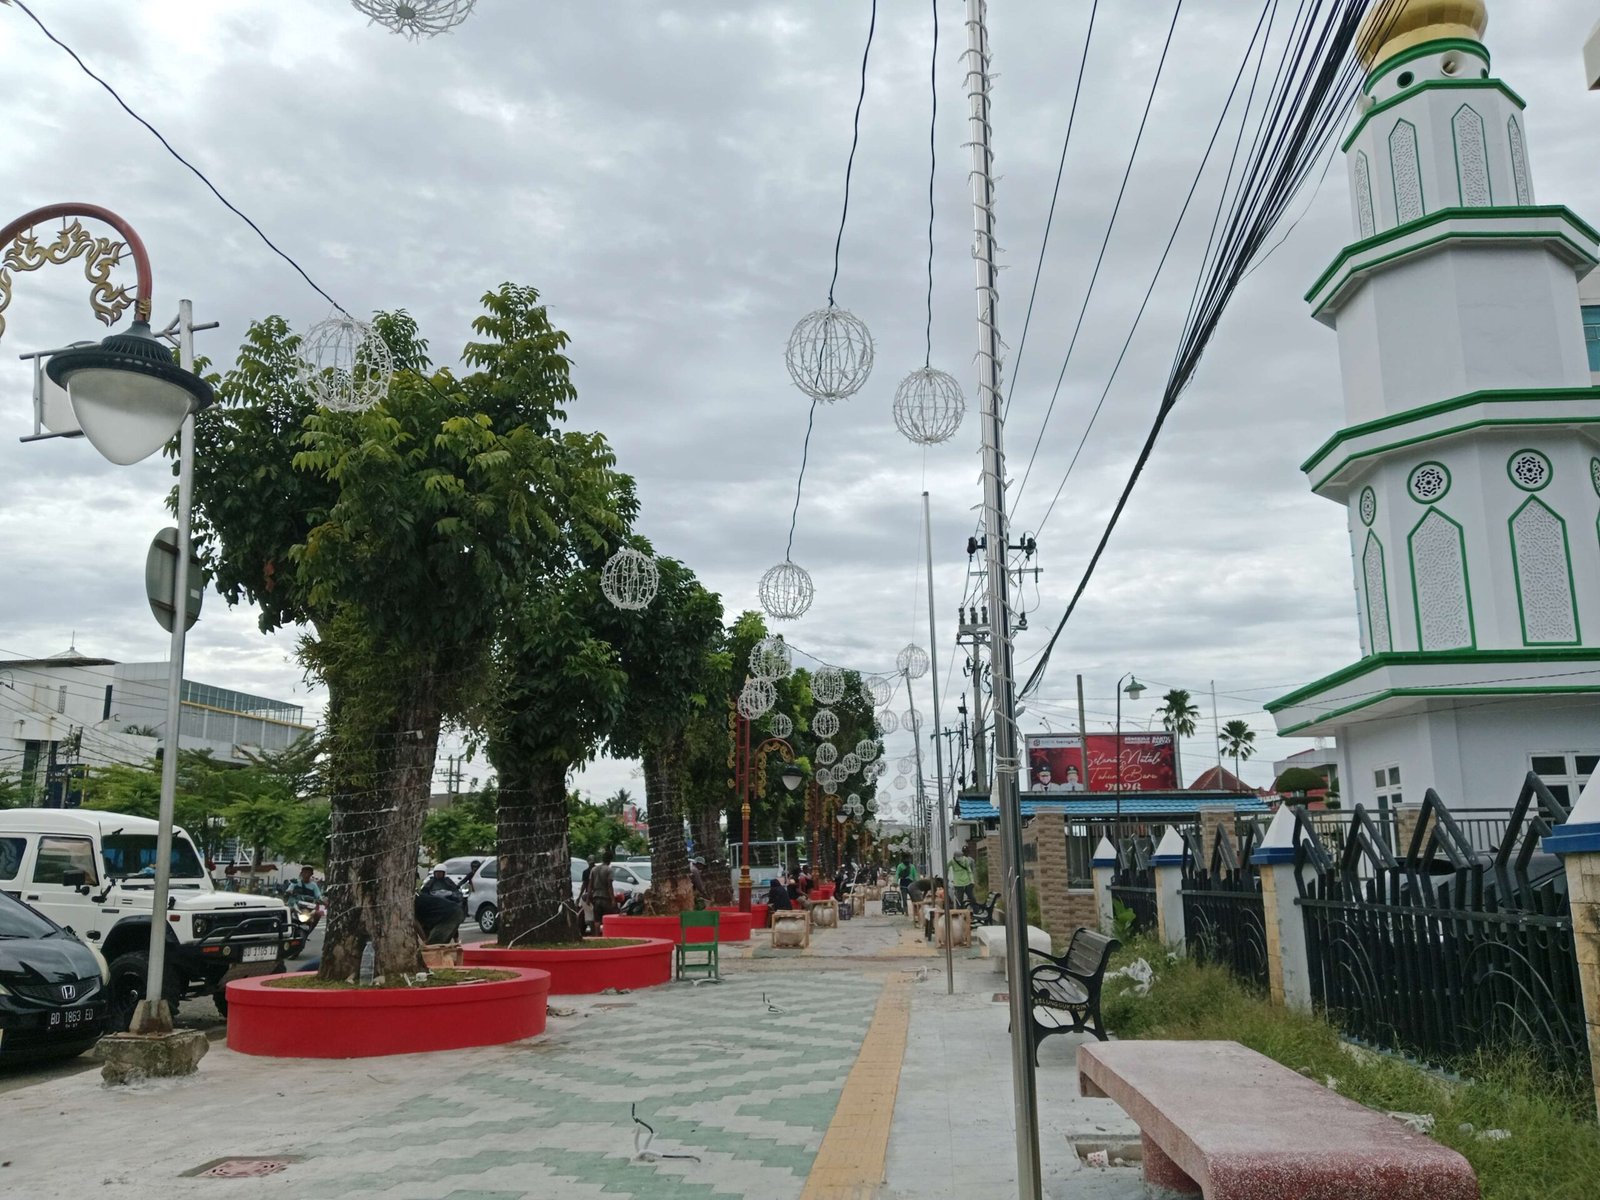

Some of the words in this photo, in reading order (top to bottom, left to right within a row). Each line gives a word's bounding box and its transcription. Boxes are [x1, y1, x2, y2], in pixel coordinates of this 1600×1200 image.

[1120, 749, 1161, 765] Natal
[1121, 764, 1158, 783] Baru
[50, 1012, 60, 1025] BD
[65, 1010, 81, 1023] 1863
[85, 1009, 94, 1020] ED
